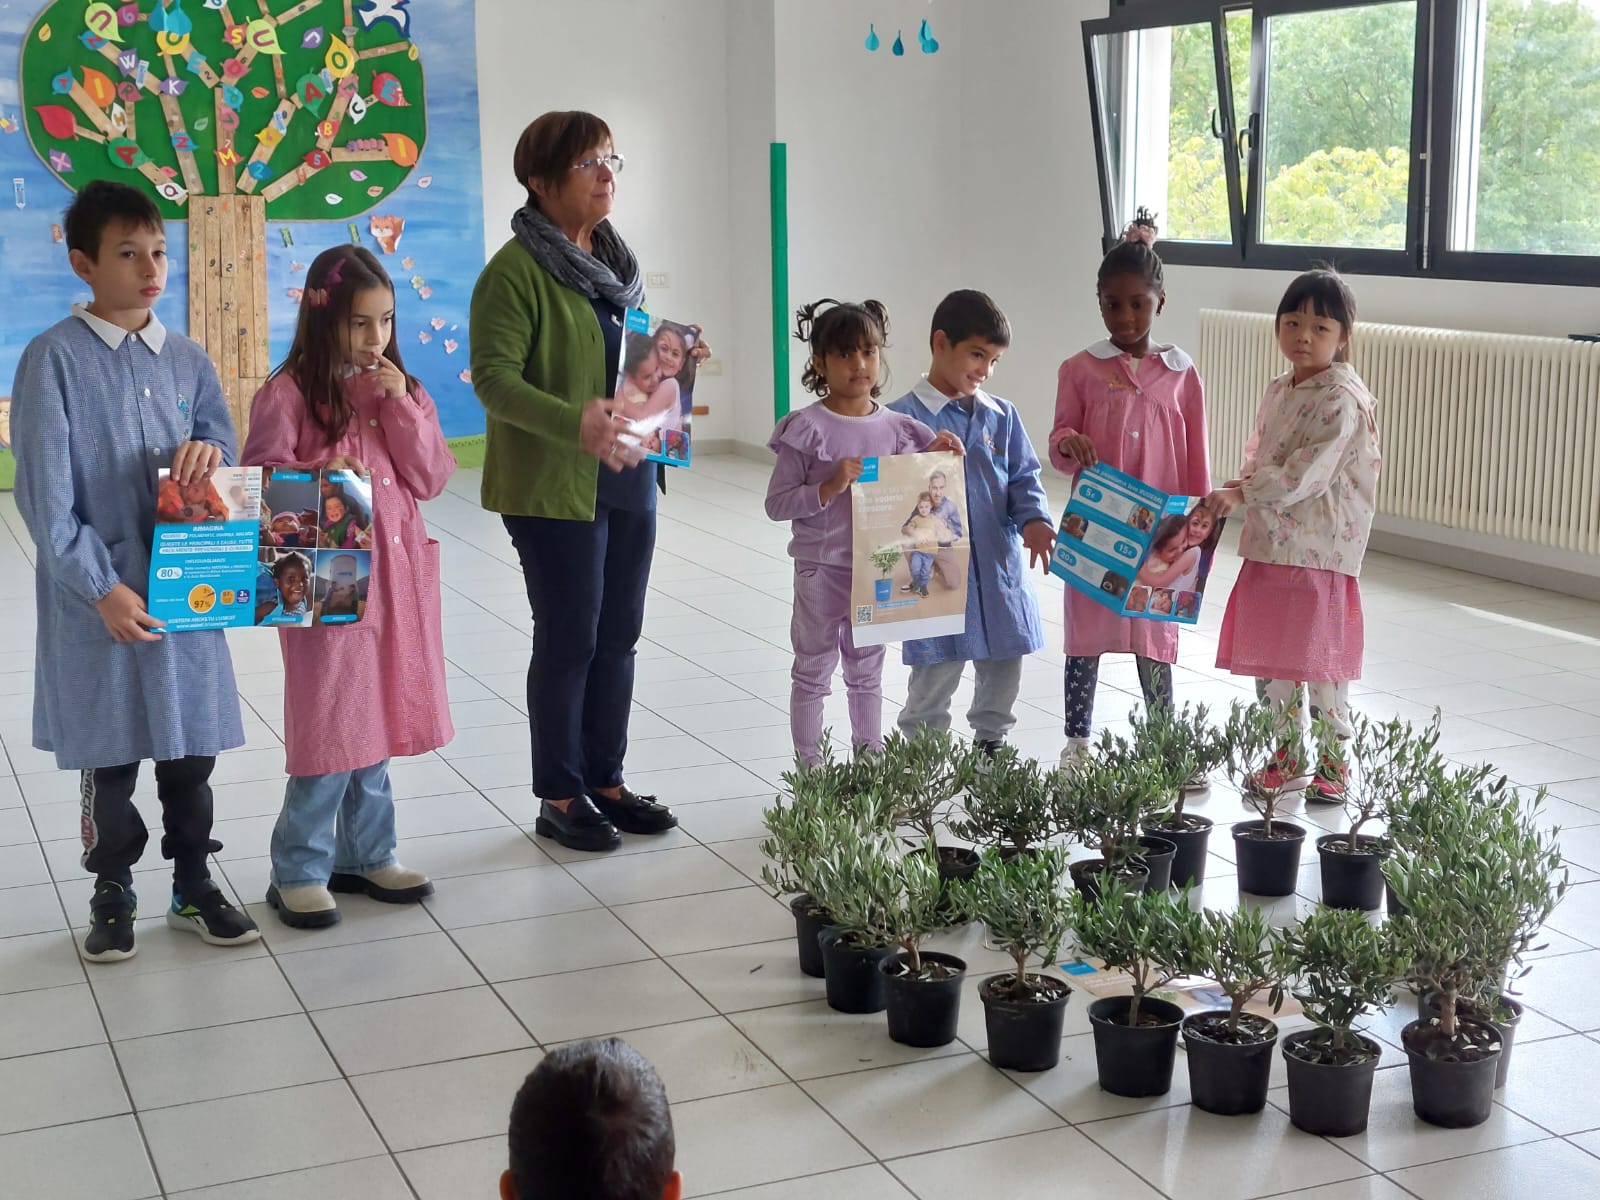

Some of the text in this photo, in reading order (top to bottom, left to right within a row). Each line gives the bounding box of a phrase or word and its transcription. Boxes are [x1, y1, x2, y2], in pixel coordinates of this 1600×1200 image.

[231, 28, 243, 44] S
[119, 54, 136, 69] W
[168, 80, 180, 95] K
[305, 82, 324, 103] A
[380, 79, 400, 102] E
[351, 101, 363, 114] C
[323, 121, 332, 136] B
[50, 152, 71, 172] X
[218, 148, 237, 166] M
[226, 263, 233, 272] 2
[223, 302, 230, 311] 2
